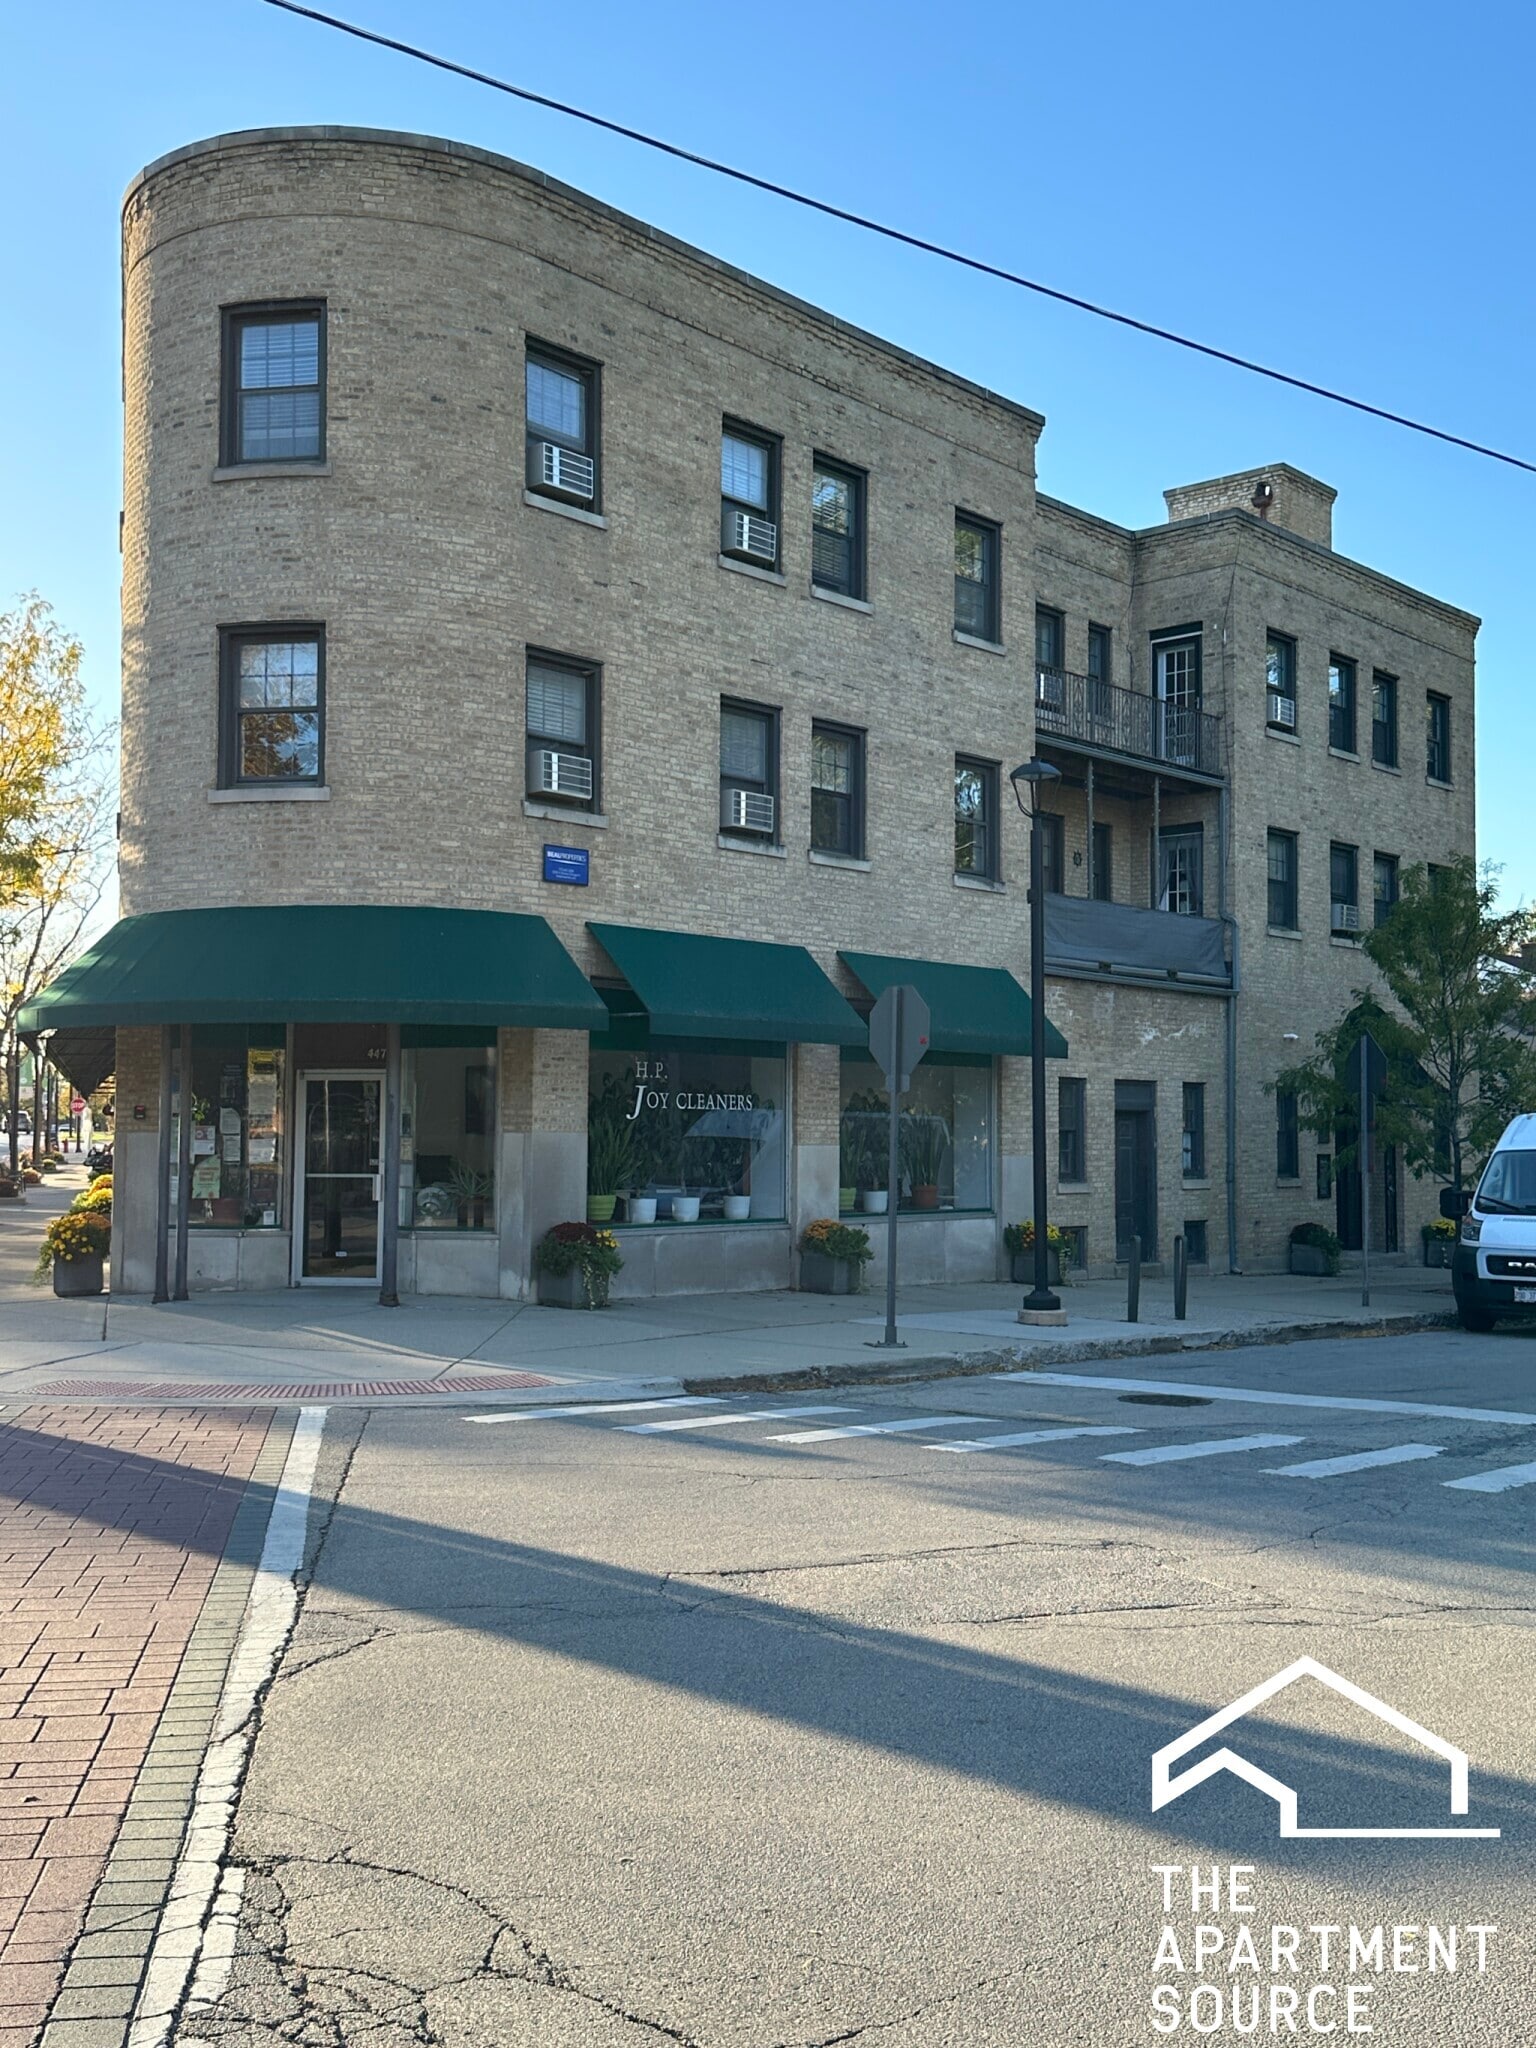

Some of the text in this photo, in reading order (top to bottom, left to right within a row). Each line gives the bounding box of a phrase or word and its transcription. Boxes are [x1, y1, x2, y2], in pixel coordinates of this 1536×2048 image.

[367, 1048, 387, 1059] 447
[635, 1061, 668, 1079] H.P.
[625, 1085, 753, 1120] JOY CLEANERS
